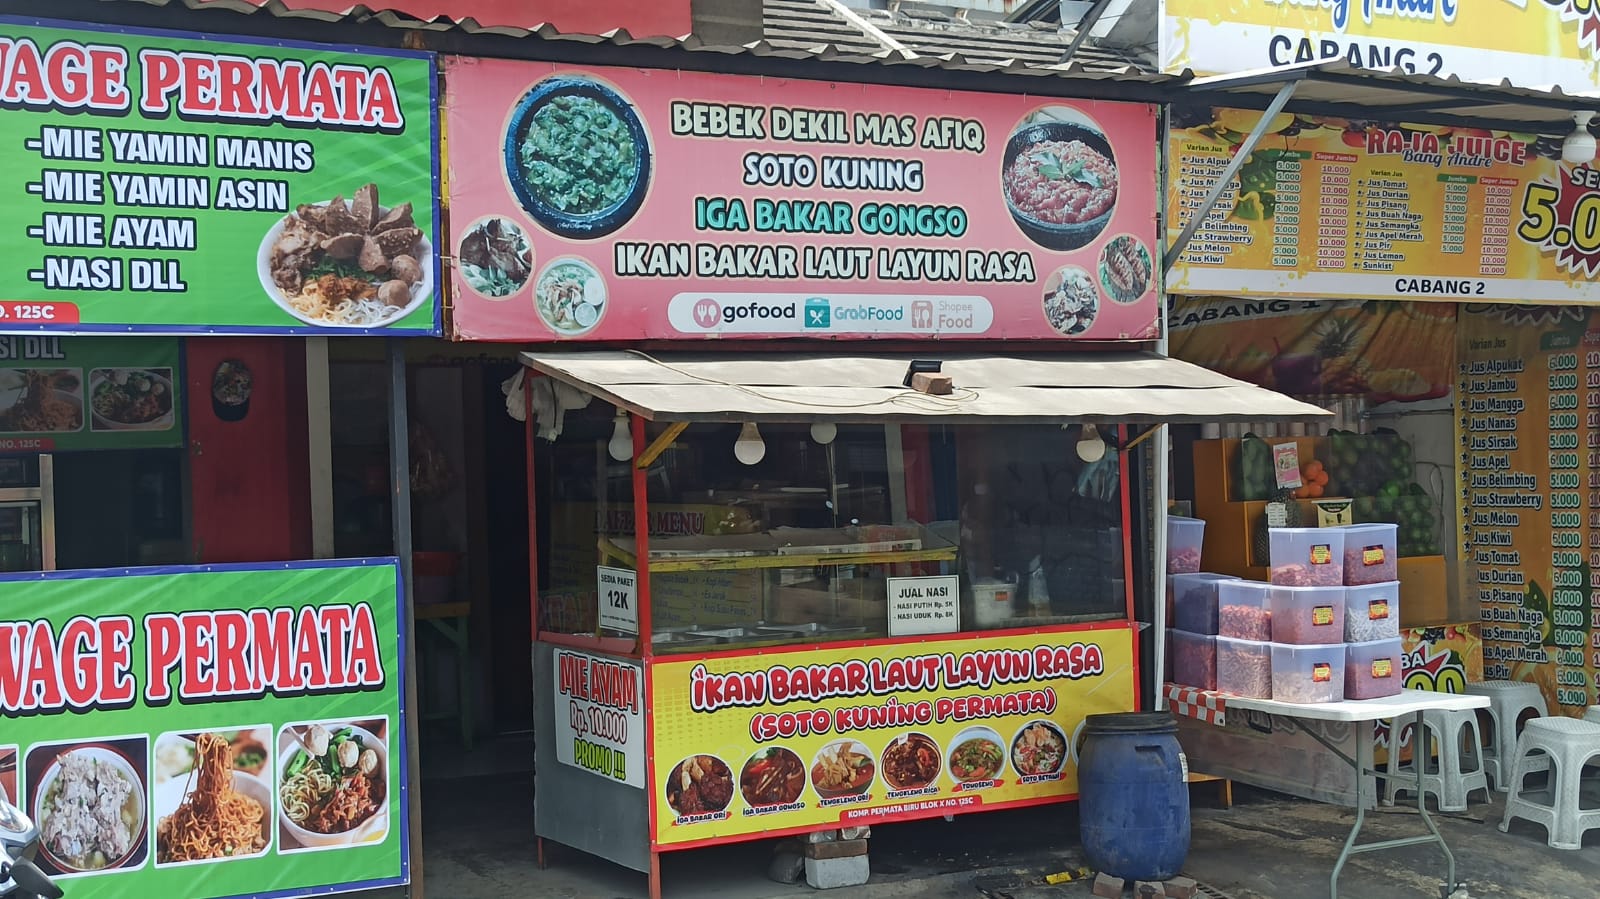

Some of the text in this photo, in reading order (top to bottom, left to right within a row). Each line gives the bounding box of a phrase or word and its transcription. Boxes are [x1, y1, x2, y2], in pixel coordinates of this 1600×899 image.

[140, 50, 404, 129] PERMATA
[673, 104, 984, 152] BEBEK DEKIL MAS AFIQ
[110, 131, 207, 165] YAMIN
[216, 137, 313, 171] MANIS
[1366, 129, 1526, 166] RAJA JUICE
[1402, 149, 1492, 167] Bang Andre
[744, 154, 923, 191] SOTO KUNING
[1277, 162, 1300, 170] 5.000
[1322, 166, 1349, 174] 10.000
[1367, 179, 1406, 188] Jus Tomat
[110, 174, 209, 207] YAMIN
[216, 181, 289, 211] ASIN
[1367, 190, 1409, 199] Jus Durian
[1367, 200, 1407, 210] Jus Pisang
[696, 198, 967, 237] IGA BAKAR GONGSO
[1366, 210, 1423, 221] Jus Buah Naga
[111, 217, 197, 250] AYAM
[1205, 223, 1248, 233] Belimbing
[1380, 222, 1420, 231] Semangka
[1204, 234, 1252, 244] Strawberry
[1365, 231, 1377, 239] Jus
[1379, 232, 1397, 241] Apel
[1188, 244, 1202, 252] Jus
[615, 244, 1036, 283] IKAN BAKAR LAUT LAYUN RASA
[1188, 254, 1223, 263] Jus Kiwi
[1364, 252, 1376, 260] Jus
[1363, 262, 1393, 270] Sunkist
[131, 260, 187, 291] DLL
[1395, 278, 1485, 295] CABANG 2
[14, 305, 54, 320] 125C
[722, 303, 796, 324] gofood
[834, 306, 904, 321] GrabFood
[938, 301, 973, 313] Shopee
[938, 314, 973, 329] Food
[25, 336, 65, 359] DLL
[1469, 358, 1522, 376] Jus Alpukat
[1469, 377, 1516, 392] Jus Jambu
[1549, 375, 1577, 388] 5.000
[1469, 397, 1524, 413] Jus Mangga
[1470, 416, 1516, 430] Jus Nanas
[1550, 414, 1577, 428] 5.000
[1470, 435, 1517, 449] Jus Sirsak
[1471, 453, 1509, 471] Jus Apel
[1472, 473, 1536, 489] Jus Belimbing
[1551, 474, 1579, 487] 5.000
[1472, 493, 1542, 509] Jus Strawberry
[1473, 512, 1518, 525] Jus Melon
[1473, 531, 1511, 544] Jus Kiwi
[1474, 551, 1519, 564] Jus Tomat
[601, 575, 633, 587] SEDIA PAKET
[1492, 570, 1523, 584] Durian
[608, 590, 629, 610] 12K
[898, 587, 948, 598] JUAL NASI
[1492, 589, 1523, 605] Pisang
[1493, 609, 1543, 625] Buah Naga
[1493, 628, 1541, 644] Semangka
[145, 602, 385, 701] PERMATA
[1495, 648, 1548, 664] Apel Merah
[691, 643, 1103, 711] IKAN BAKAR LAUT LAYUN RASA
[1496, 665, 1509, 678] Pir
[559, 653, 638, 714] MIE AYAM
[570, 701, 628, 744] Rp. 10.000
[750, 688, 1057, 743] (SOTO KUNING PERMATA)
[574, 739, 612, 776] PROMO
[870, 805, 903, 815] PERMATA
[903, 803, 920, 812] BIRU
[920, 801, 938, 810] BLOK
